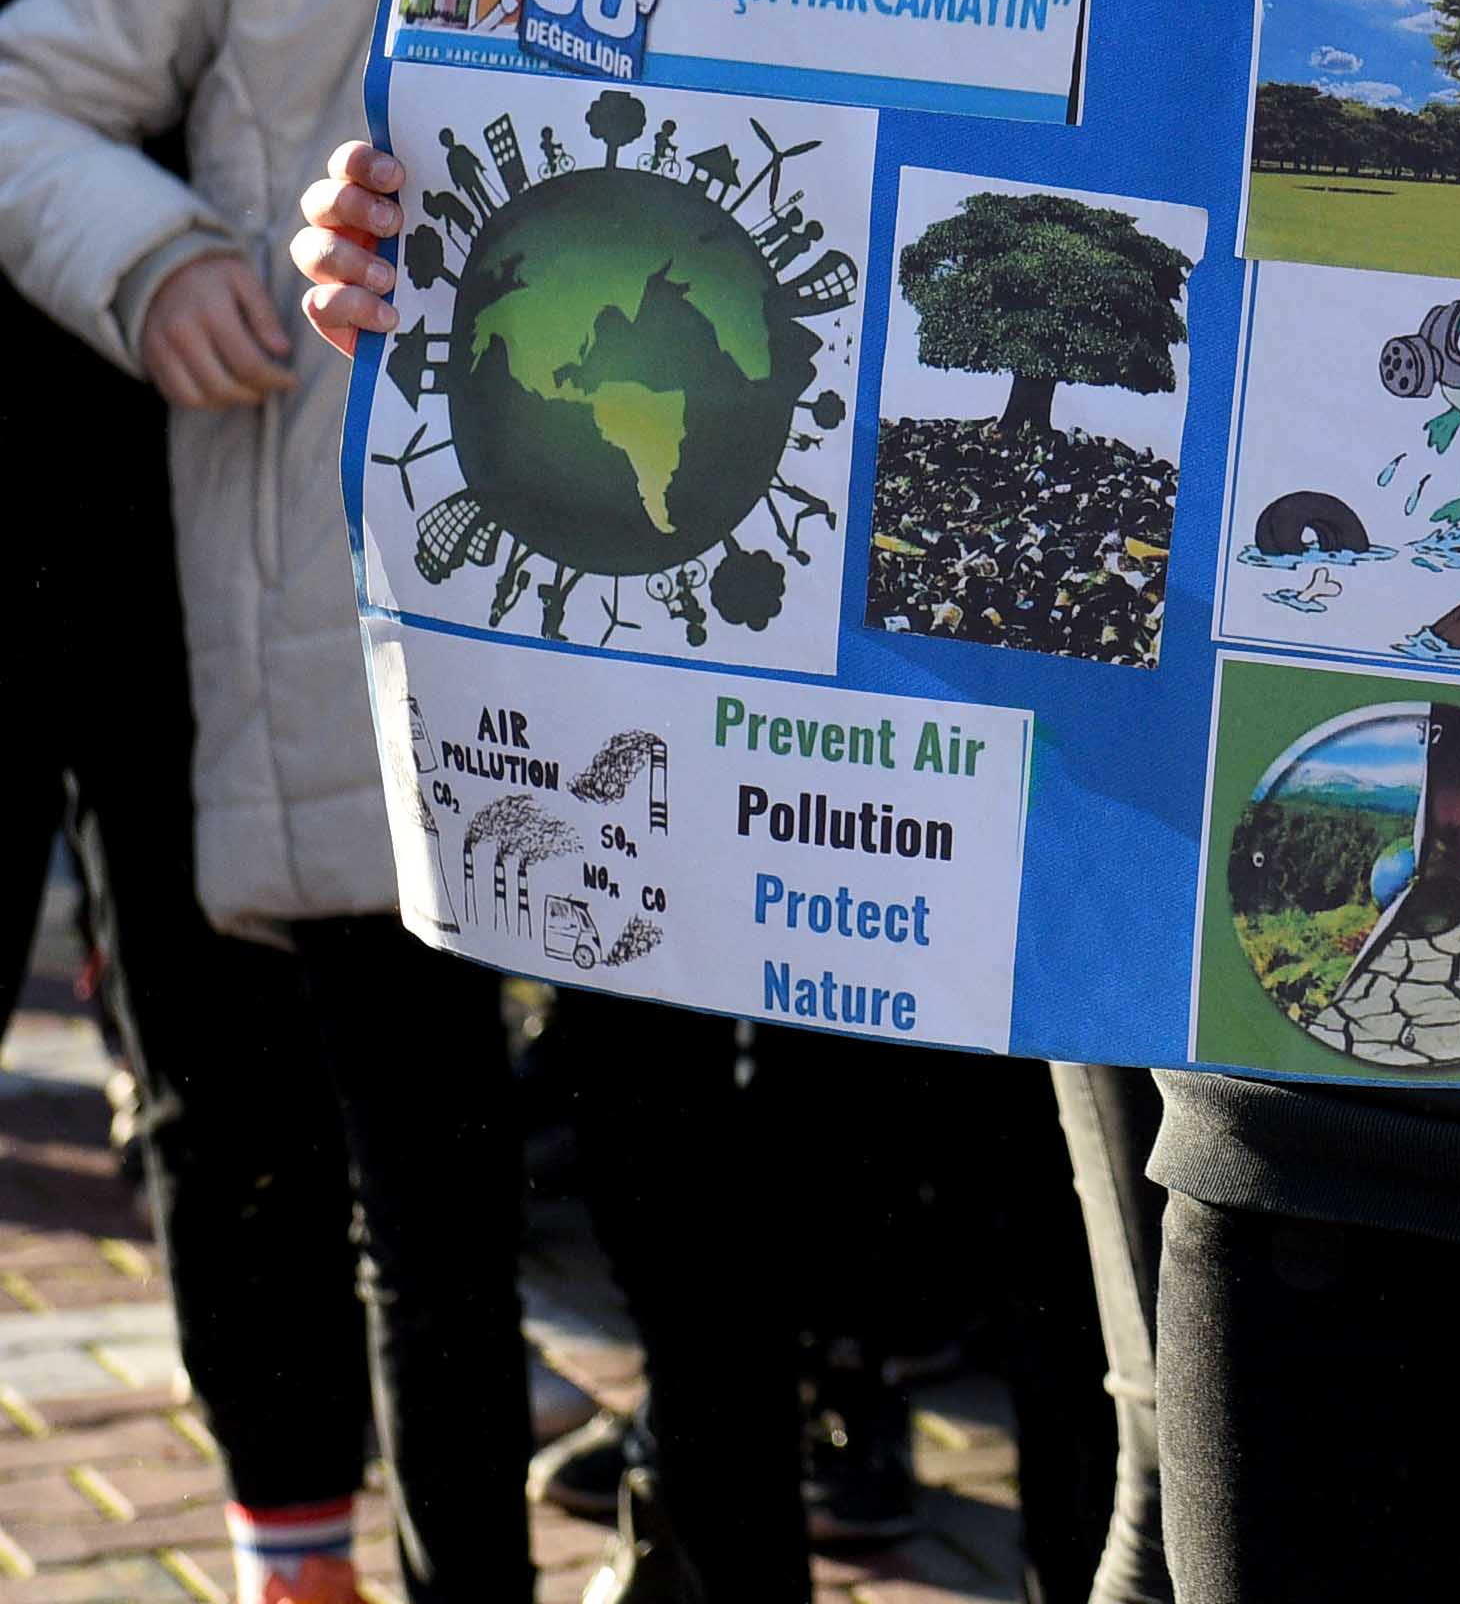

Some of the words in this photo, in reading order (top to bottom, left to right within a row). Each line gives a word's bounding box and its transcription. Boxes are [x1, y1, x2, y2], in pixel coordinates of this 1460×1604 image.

[477, 705, 531, 750] AIR
[715, 695, 896, 770] Prevent
[913, 721, 986, 777] Air
[441, 740, 560, 792] POLLUTION
[737, 784, 954, 861] Pollution
[641, 885, 667, 913] CO
[755, 872, 931, 946] Protect
[763, 959, 917, 1032] Nature
